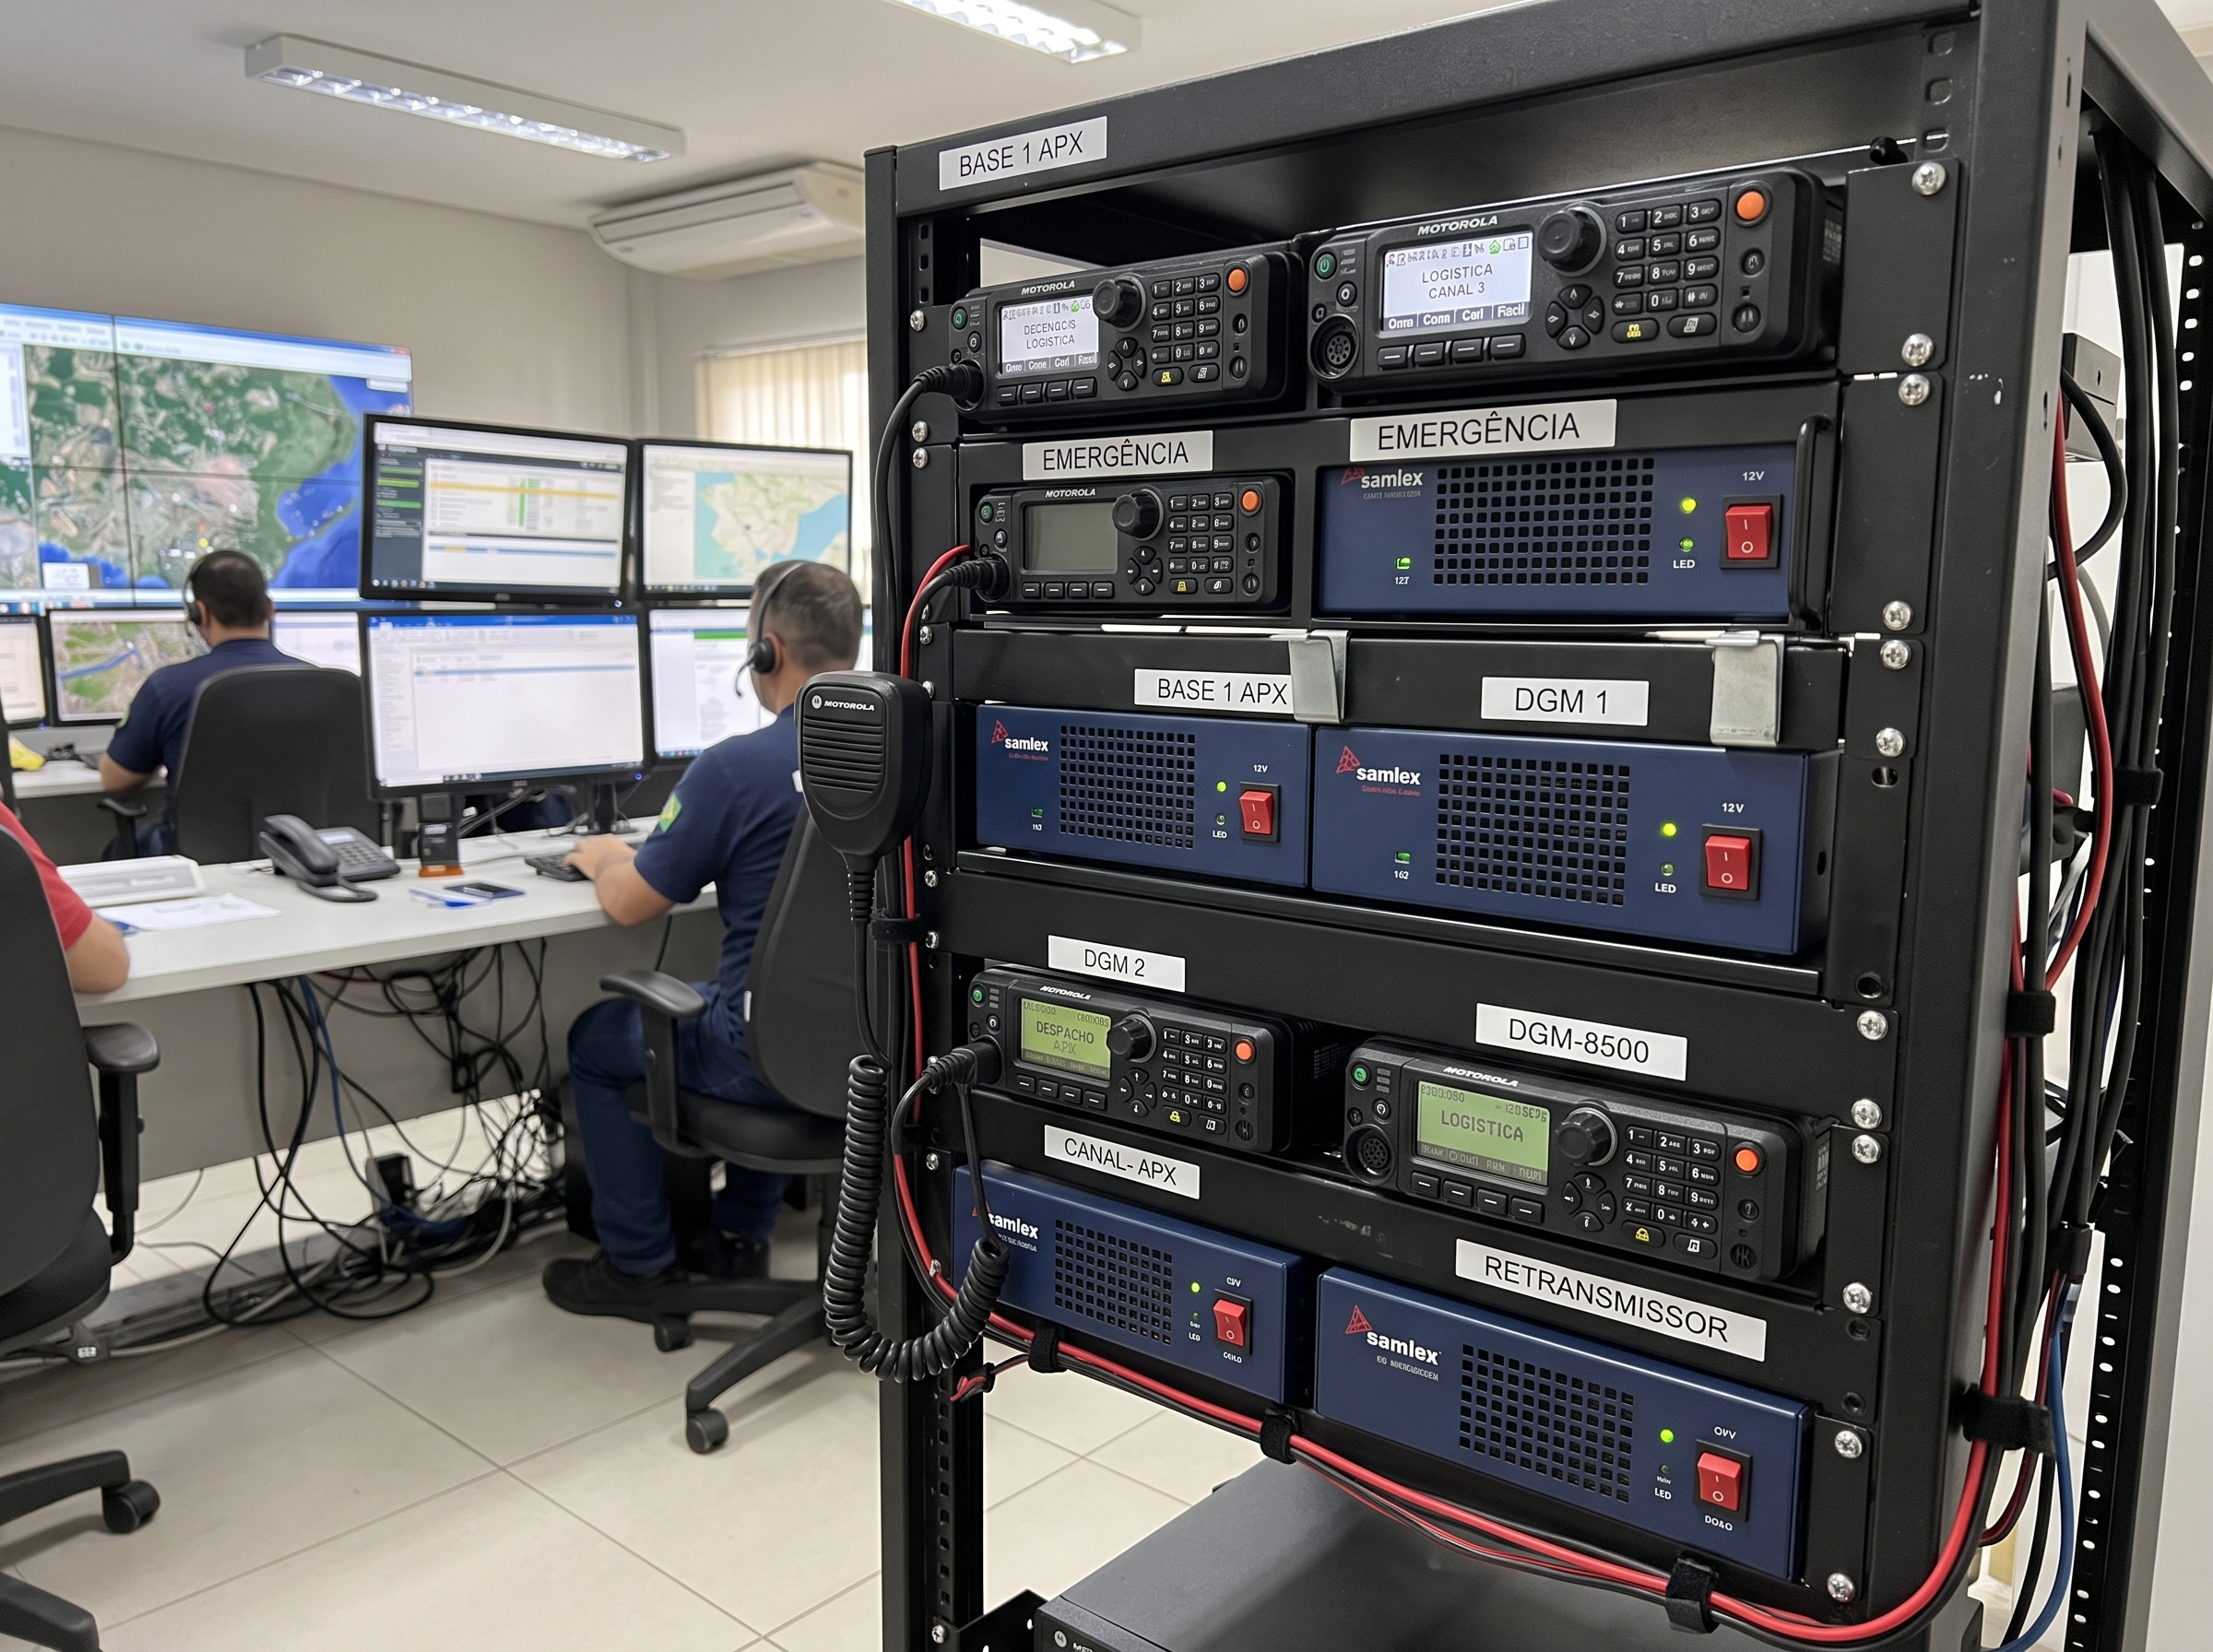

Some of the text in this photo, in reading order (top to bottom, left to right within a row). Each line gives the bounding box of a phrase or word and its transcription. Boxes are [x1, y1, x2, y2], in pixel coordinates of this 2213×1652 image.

[959, 130, 1084, 177] BASE 1 APX
[1654, 211, 1663, 223] 2
[1691, 206, 1698, 218] 3
[1417, 215, 1498, 236] MOTOROLA
[1617, 243, 1626, 254] 4
[1652, 239, 1661, 251] 5
[1688, 234, 1698, 247] 6
[1421, 263, 1494, 284] LOGISTICA
[1651, 266, 1660, 279] 8
[1687, 263, 1696, 275] 9
[1021, 279, 1076, 296] MOTOROLA
[1428, 281, 1485, 300] CANAL 3
[1026, 334, 1075, 350] LOGISTICA
[1378, 410, 1580, 451] EMERGÊNCIA
[1043, 438, 1189, 471] EMERGÊNCIA
[1361, 468, 1424, 489] samlex
[1742, 470, 1765, 481] 12V
[1045, 488, 1095, 498] MOTOROLA
[1673, 560, 1696, 569] LED
[1157, 678, 1289, 705] BASE 1 APX
[1514, 687, 1607, 714] DGM 1
[823, 700, 875, 712] MOTOROLA
[1004, 737, 1048, 751] samlex
[1253, 764, 1268, 773] 12V
[1356, 766, 1421, 785] samlex
[1722, 802, 1745, 813] 12V
[1393, 870, 1409, 879] 162
[1654, 882, 1676, 893] LED
[1084, 949, 1145, 977] DGM 2
[1036, 1021, 1095, 1044] DESPACHO
[1508, 1018, 1650, 1064] DGM-8500
[1442, 1066, 1519, 1088] MOTOROLA
[1440, 1110, 1524, 1143] LOGISTICA
[1660, 1136, 1667, 1148] 2
[1693, 1143, 1700, 1154] 3
[1626, 1154, 1633, 1164] 4
[1659, 1161, 1666, 1172] 5
[1692, 1167, 1699, 1179] 6
[1626, 1177, 1633, 1188] 7
[1658, 1185, 1665, 1196] 8
[1485, 1255, 1729, 1343] RETRANSMISSOR
[1367, 1331, 1438, 1365] samlex
[1654, 1487, 1672, 1500] LED
